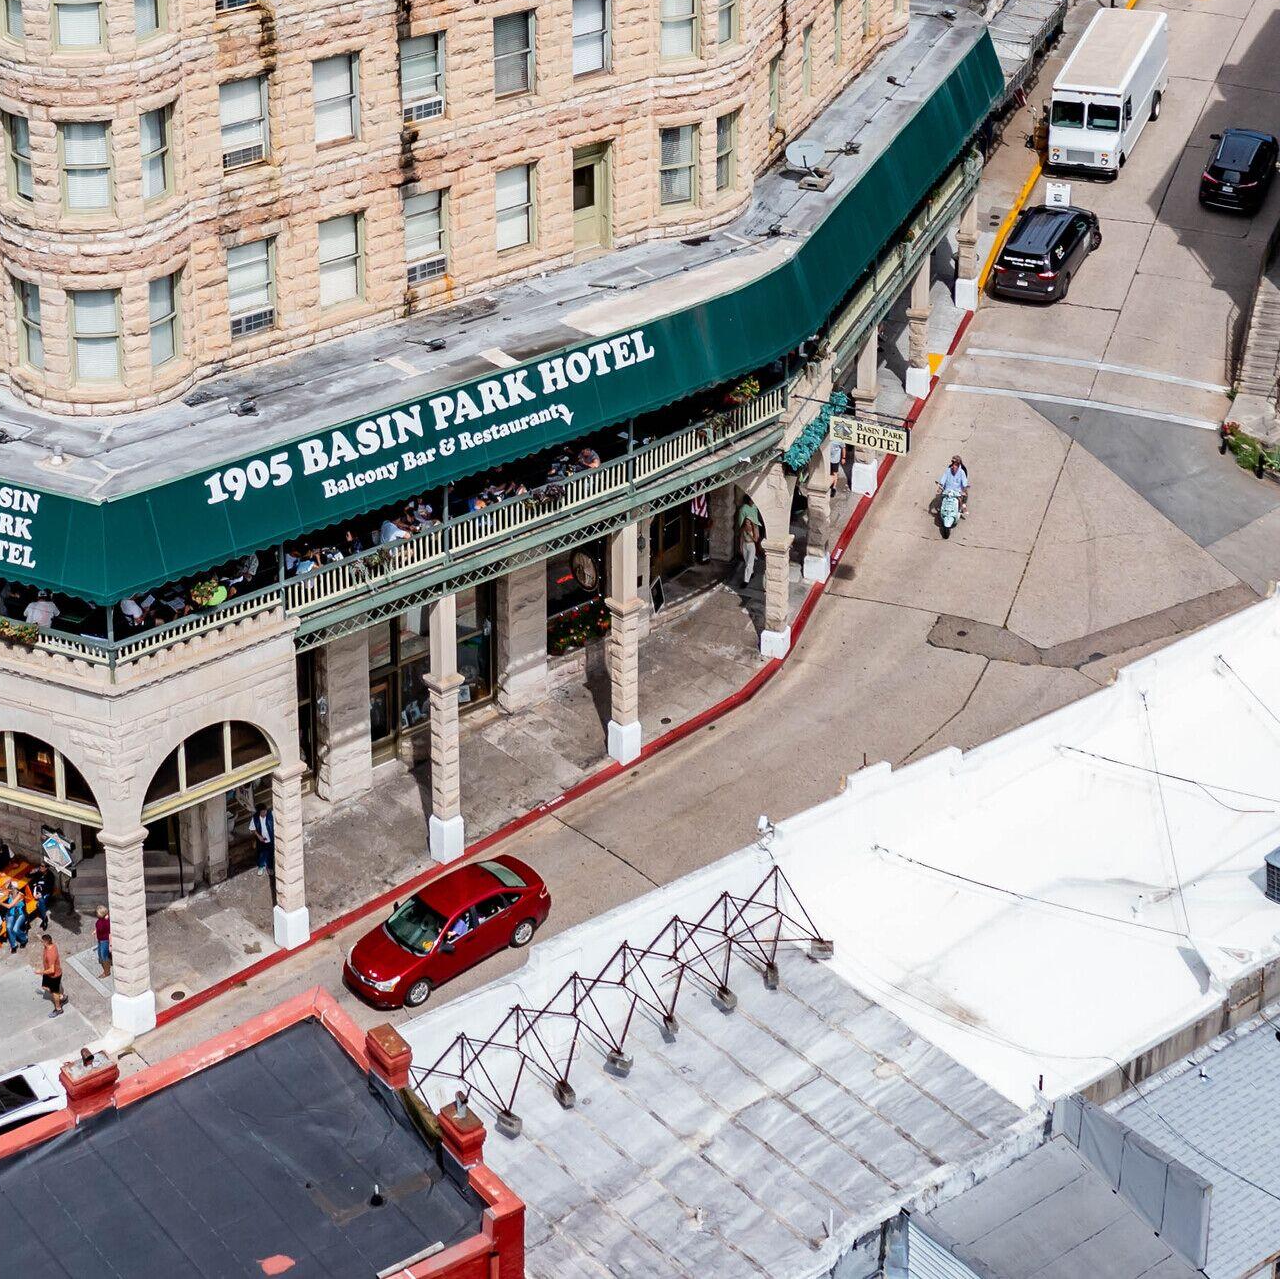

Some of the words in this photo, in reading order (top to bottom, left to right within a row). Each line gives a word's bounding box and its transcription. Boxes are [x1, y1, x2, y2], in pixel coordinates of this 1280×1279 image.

[204, 452, 293, 505] 1905
[297, 404, 424, 476] BASIN
[429, 368, 537, 431] PARK
[537, 330, 655, 395] HOTEL
[856, 422, 881, 435] BASIN
[882, 428, 904, 441] PARK
[856, 432, 904, 454] HOTEL
[321, 459, 400, 499] Balcony
[401, 447, 437, 472] Bar
[438, 437, 456, 457] &
[458, 403, 562, 451] Restaurant
